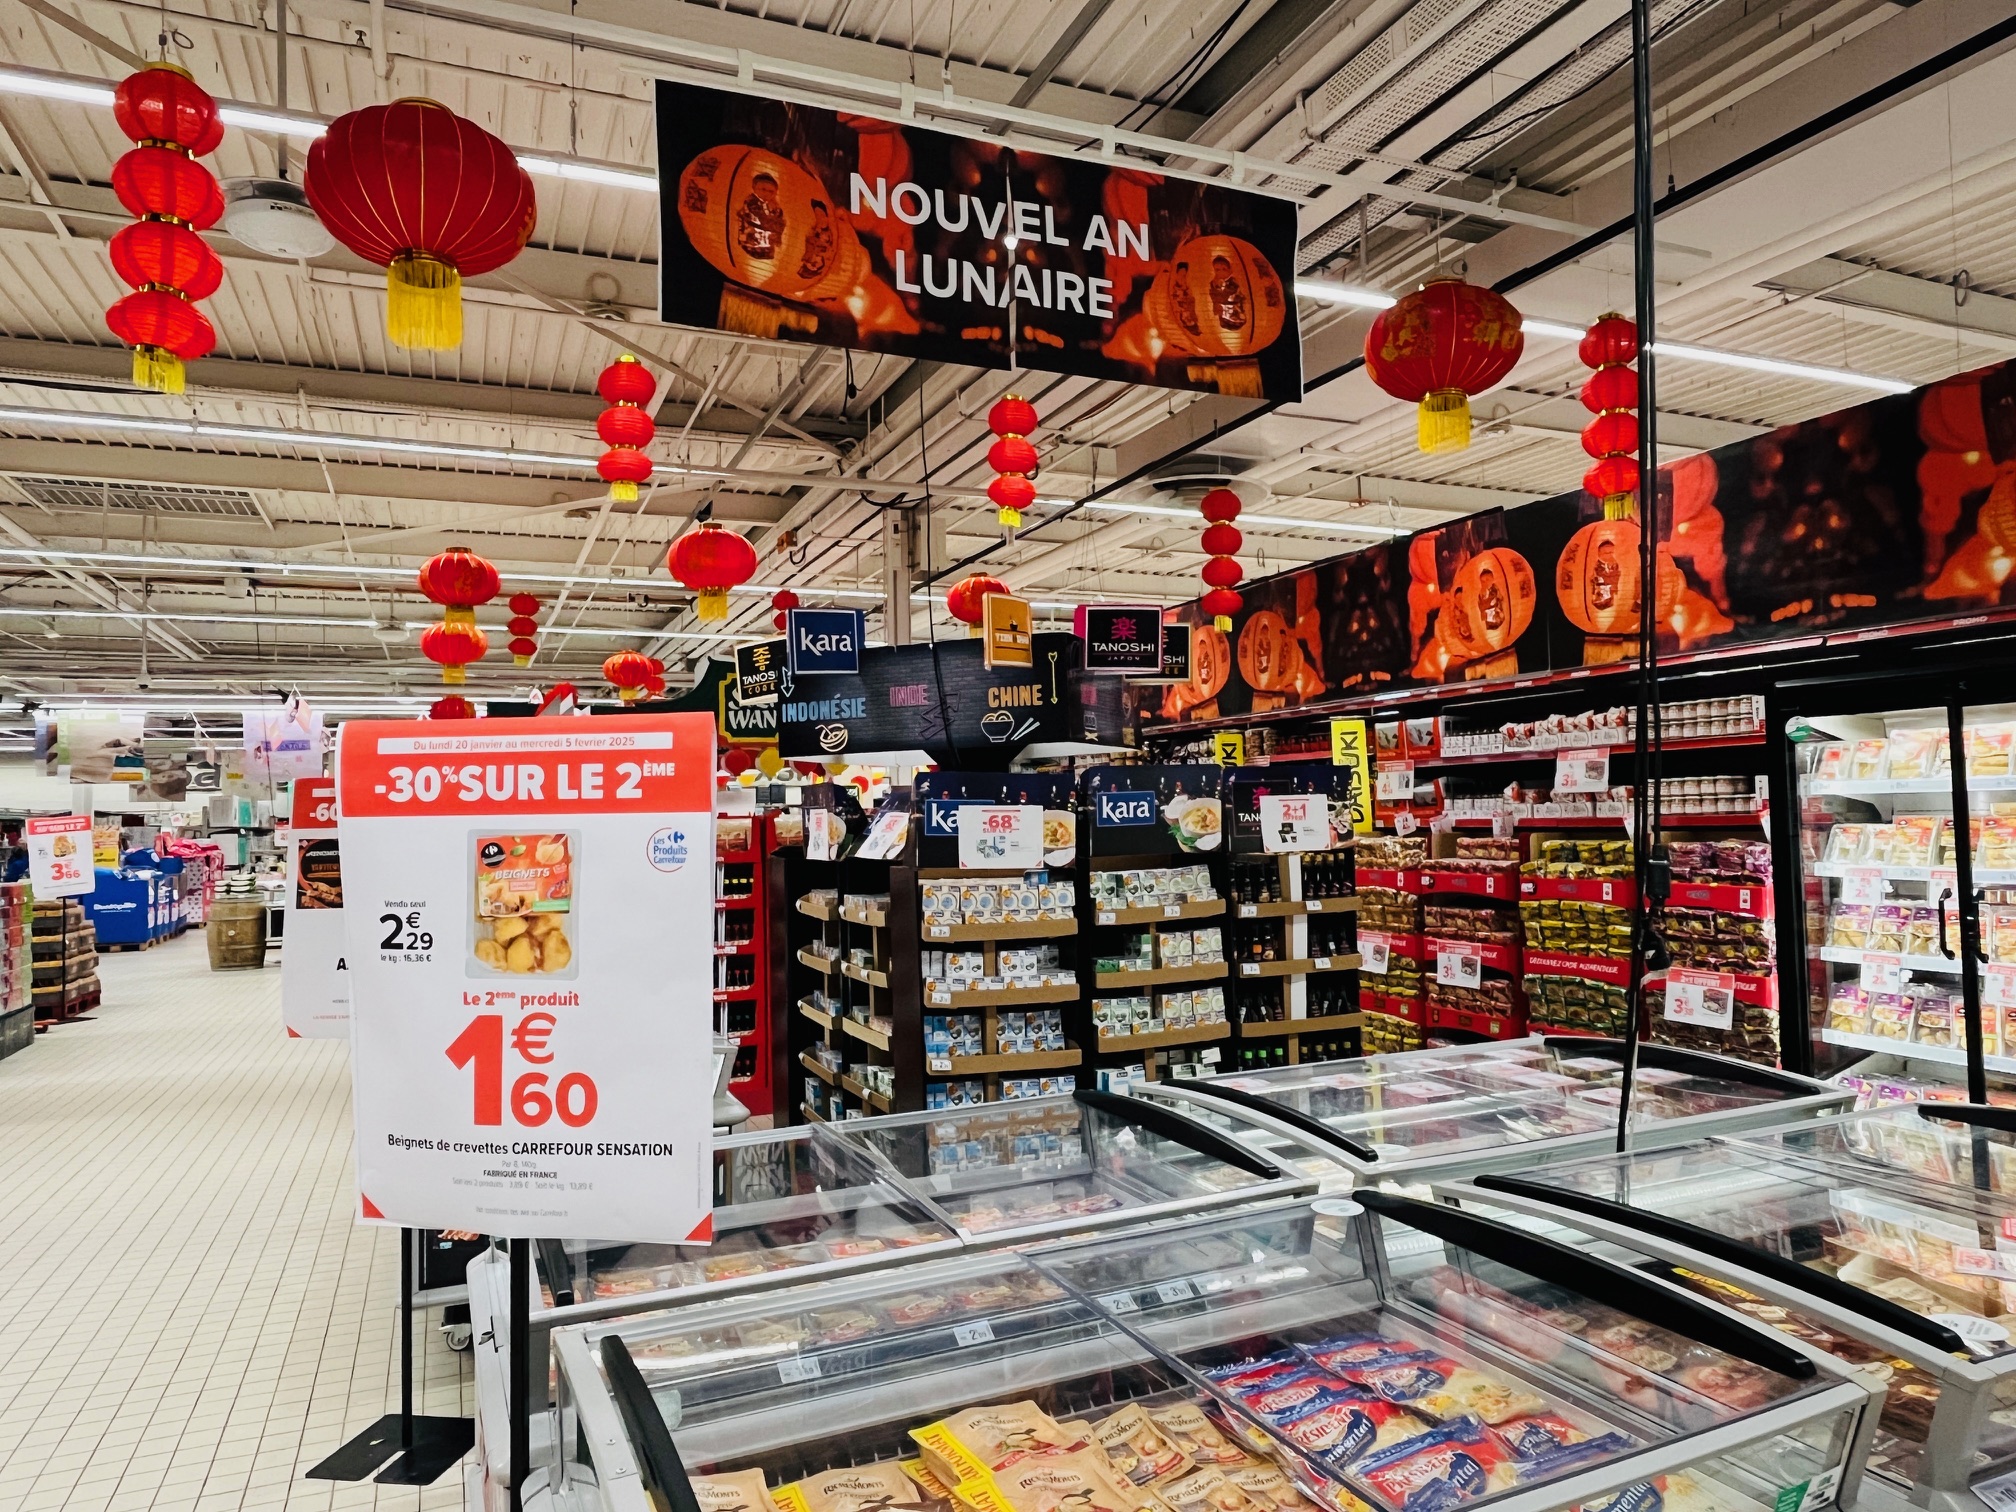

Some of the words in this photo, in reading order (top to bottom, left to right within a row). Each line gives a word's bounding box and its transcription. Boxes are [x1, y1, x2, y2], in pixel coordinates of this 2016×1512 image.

[850, 172, 1069, 246] NOUVEL
[1083, 215, 1150, 261] AN
[895, 249, 1115, 319] LUNAIRE
[801, 627, 853, 656] kara
[1092, 642, 1155, 652] TANOSHI
[890, 684, 929, 707] INDE
[988, 684, 1043, 708] CHINE
[728, 709, 777, 729] WAN
[782, 694, 867, 722] INDONÉSIE
[455, 740, 468, 750] 20
[566, 738, 572, 747] 5
[609, 736, 635, 747] 2025
[374, 765, 458, 802] -30%
[458, 764, 545, 801] SUR
[557, 763, 604, 800] LE
[1102, 796, 1150, 823] kara
[653, 836, 665, 845] Les
[653, 845, 688, 855] Produits
[495, 868, 550, 880] BEIGNETS
[463, 991, 481, 1006] Le
[520, 991, 580, 1010] produit
[388, 1134, 433, 1151] Beignets
[437, 1139, 450, 1152] de
[453, 1142, 508, 1155] crevettes
[512, 1142, 593, 1156] CARREFOUR
[597, 1142, 673, 1156] SENSATION
[483, 1169, 517, 1178] FABRIQUÉ
[530, 1171, 557, 1180] FRANCE
